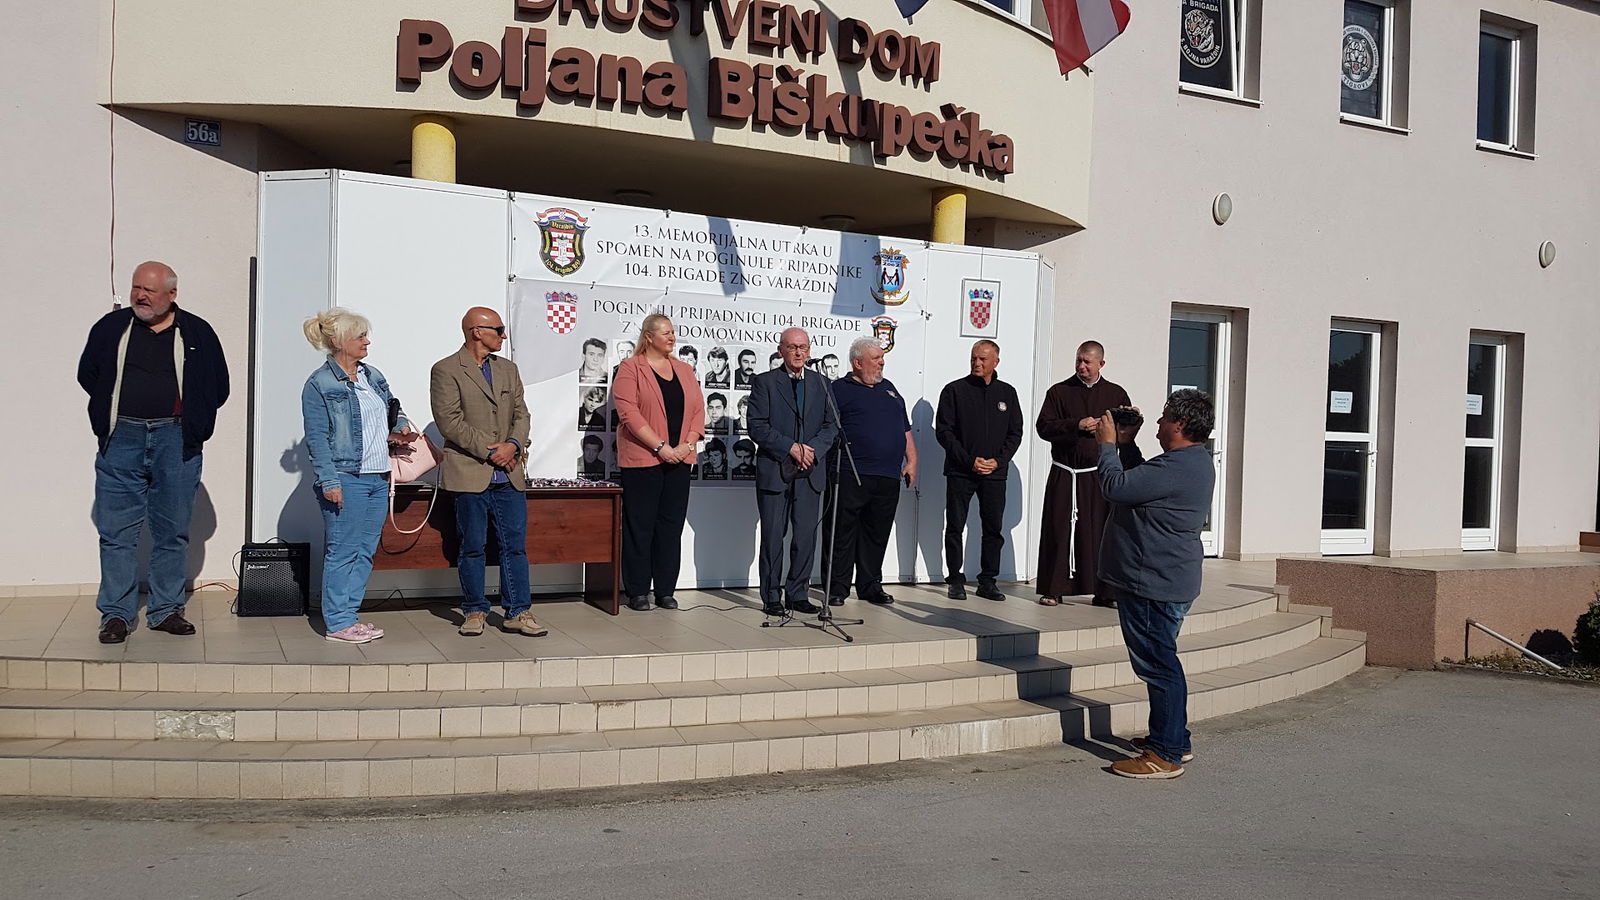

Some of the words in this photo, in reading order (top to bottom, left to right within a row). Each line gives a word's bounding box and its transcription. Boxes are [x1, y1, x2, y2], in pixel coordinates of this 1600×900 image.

[838, 17, 941, 83] DOM
[397, 18, 688, 112] Poljana
[709, 57, 1015, 175] Biškupečka
[187, 122, 218, 143] 56a
[596, 240, 664, 258] SPOMEN
[670, 247, 692, 261] NA
[697, 250, 774, 270] POGINULE
[634, 224, 653, 239] 13.
[657, 226, 768, 251] MEMORIJALNA
[772, 239, 818, 256] UTRKA
[823, 245, 833, 258] U
[625, 262, 652, 277] 104.
[658, 264, 726, 284] BRIGADE
[730, 271, 762, 287] ZNG
[767, 275, 838, 294] VARAŽDIN
[680, 306, 767, 325] PRIPADNICI
[773, 314, 797, 327] 104.
[801, 316, 861, 332] BRIGADE
[679, 324, 781, 344] DOMOVINSKO
[810, 334, 837, 348] ATU
